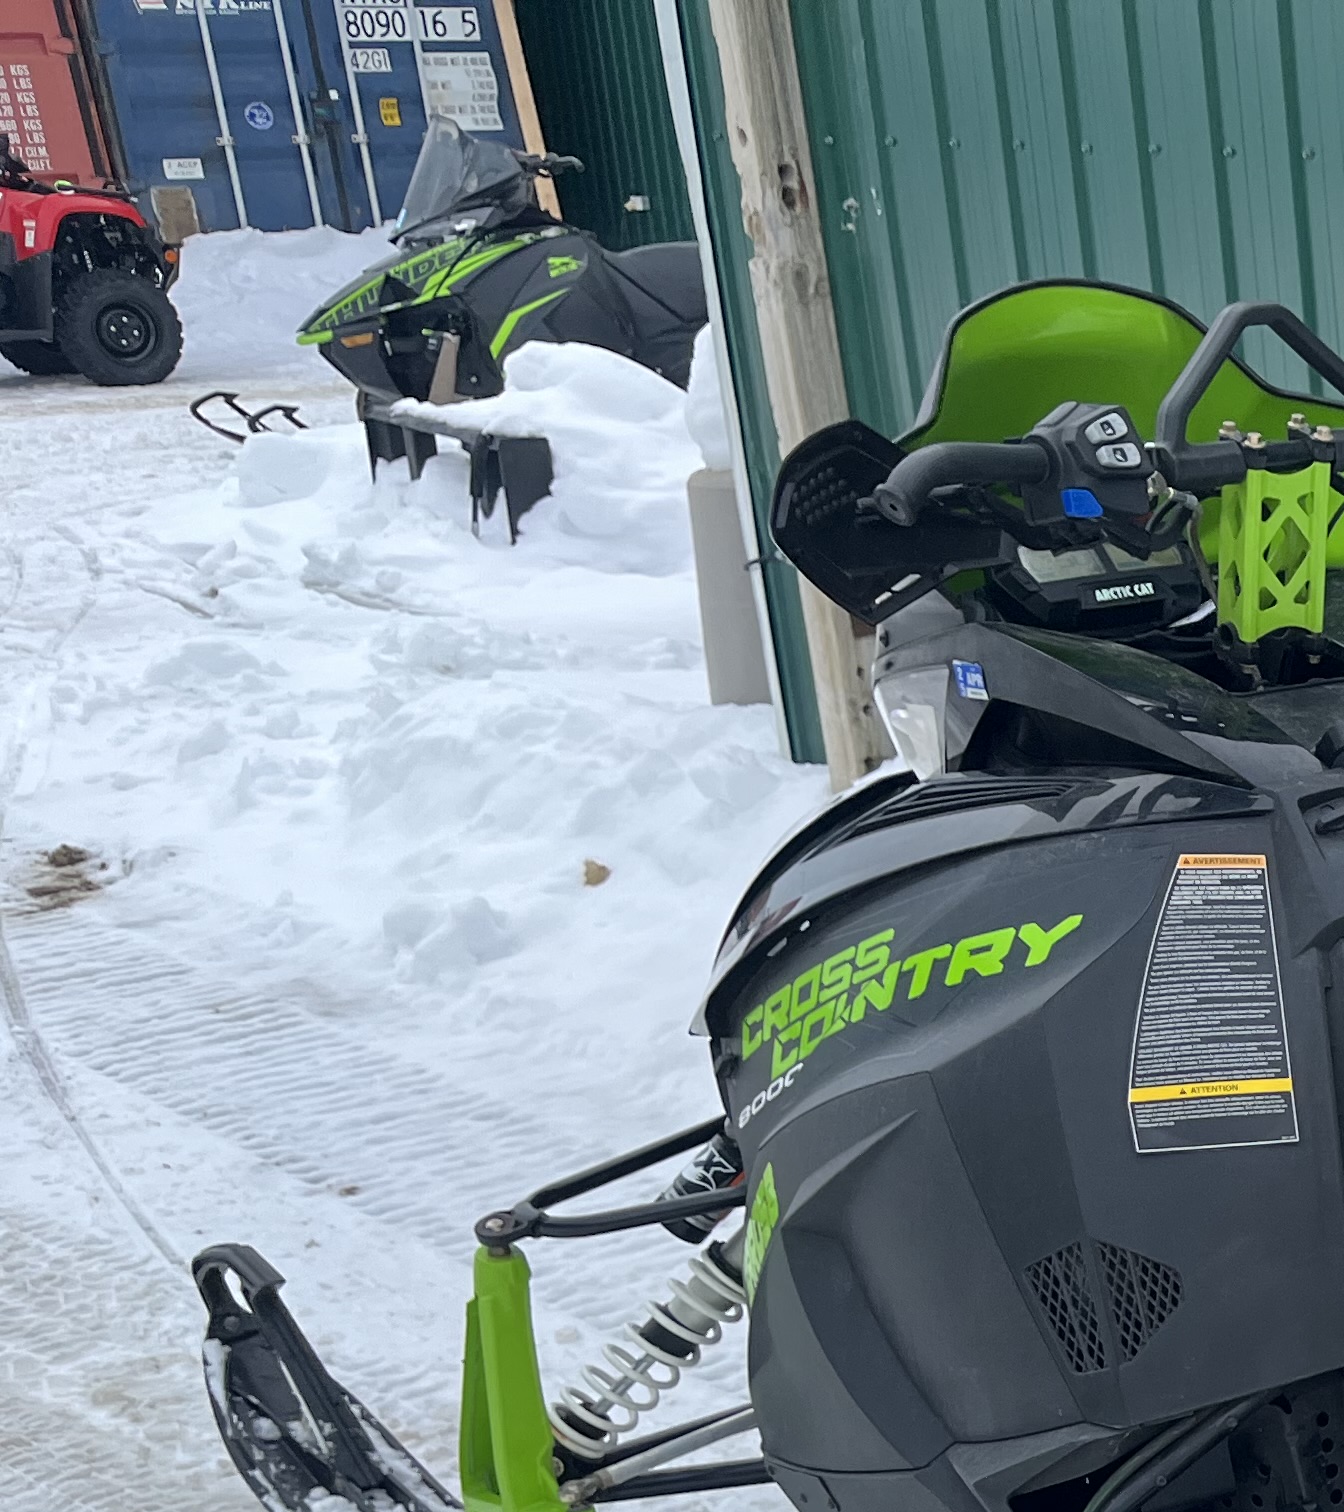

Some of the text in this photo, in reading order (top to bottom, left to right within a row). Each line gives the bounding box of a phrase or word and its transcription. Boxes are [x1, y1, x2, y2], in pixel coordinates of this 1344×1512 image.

[345, 9, 477, 38] 8090 16 5
[10, 65, 30, 76] KGS
[13, 78, 33, 89] LBS
[16, 92, 36, 103] KGS
[20, 105, 40, 117] LBS
[23, 119, 43, 131] KGS
[26, 132, 46, 144] LBS
[1094, 582, 1155, 602] ARCTIC CAT
[1192, 857, 1262, 865] AVERTISSEMENT
[741, 927, 896, 1062] CROSS
[771, 913, 1084, 1081] COUNTRY
[1190, 1083, 1240, 1095] ATTENTION
